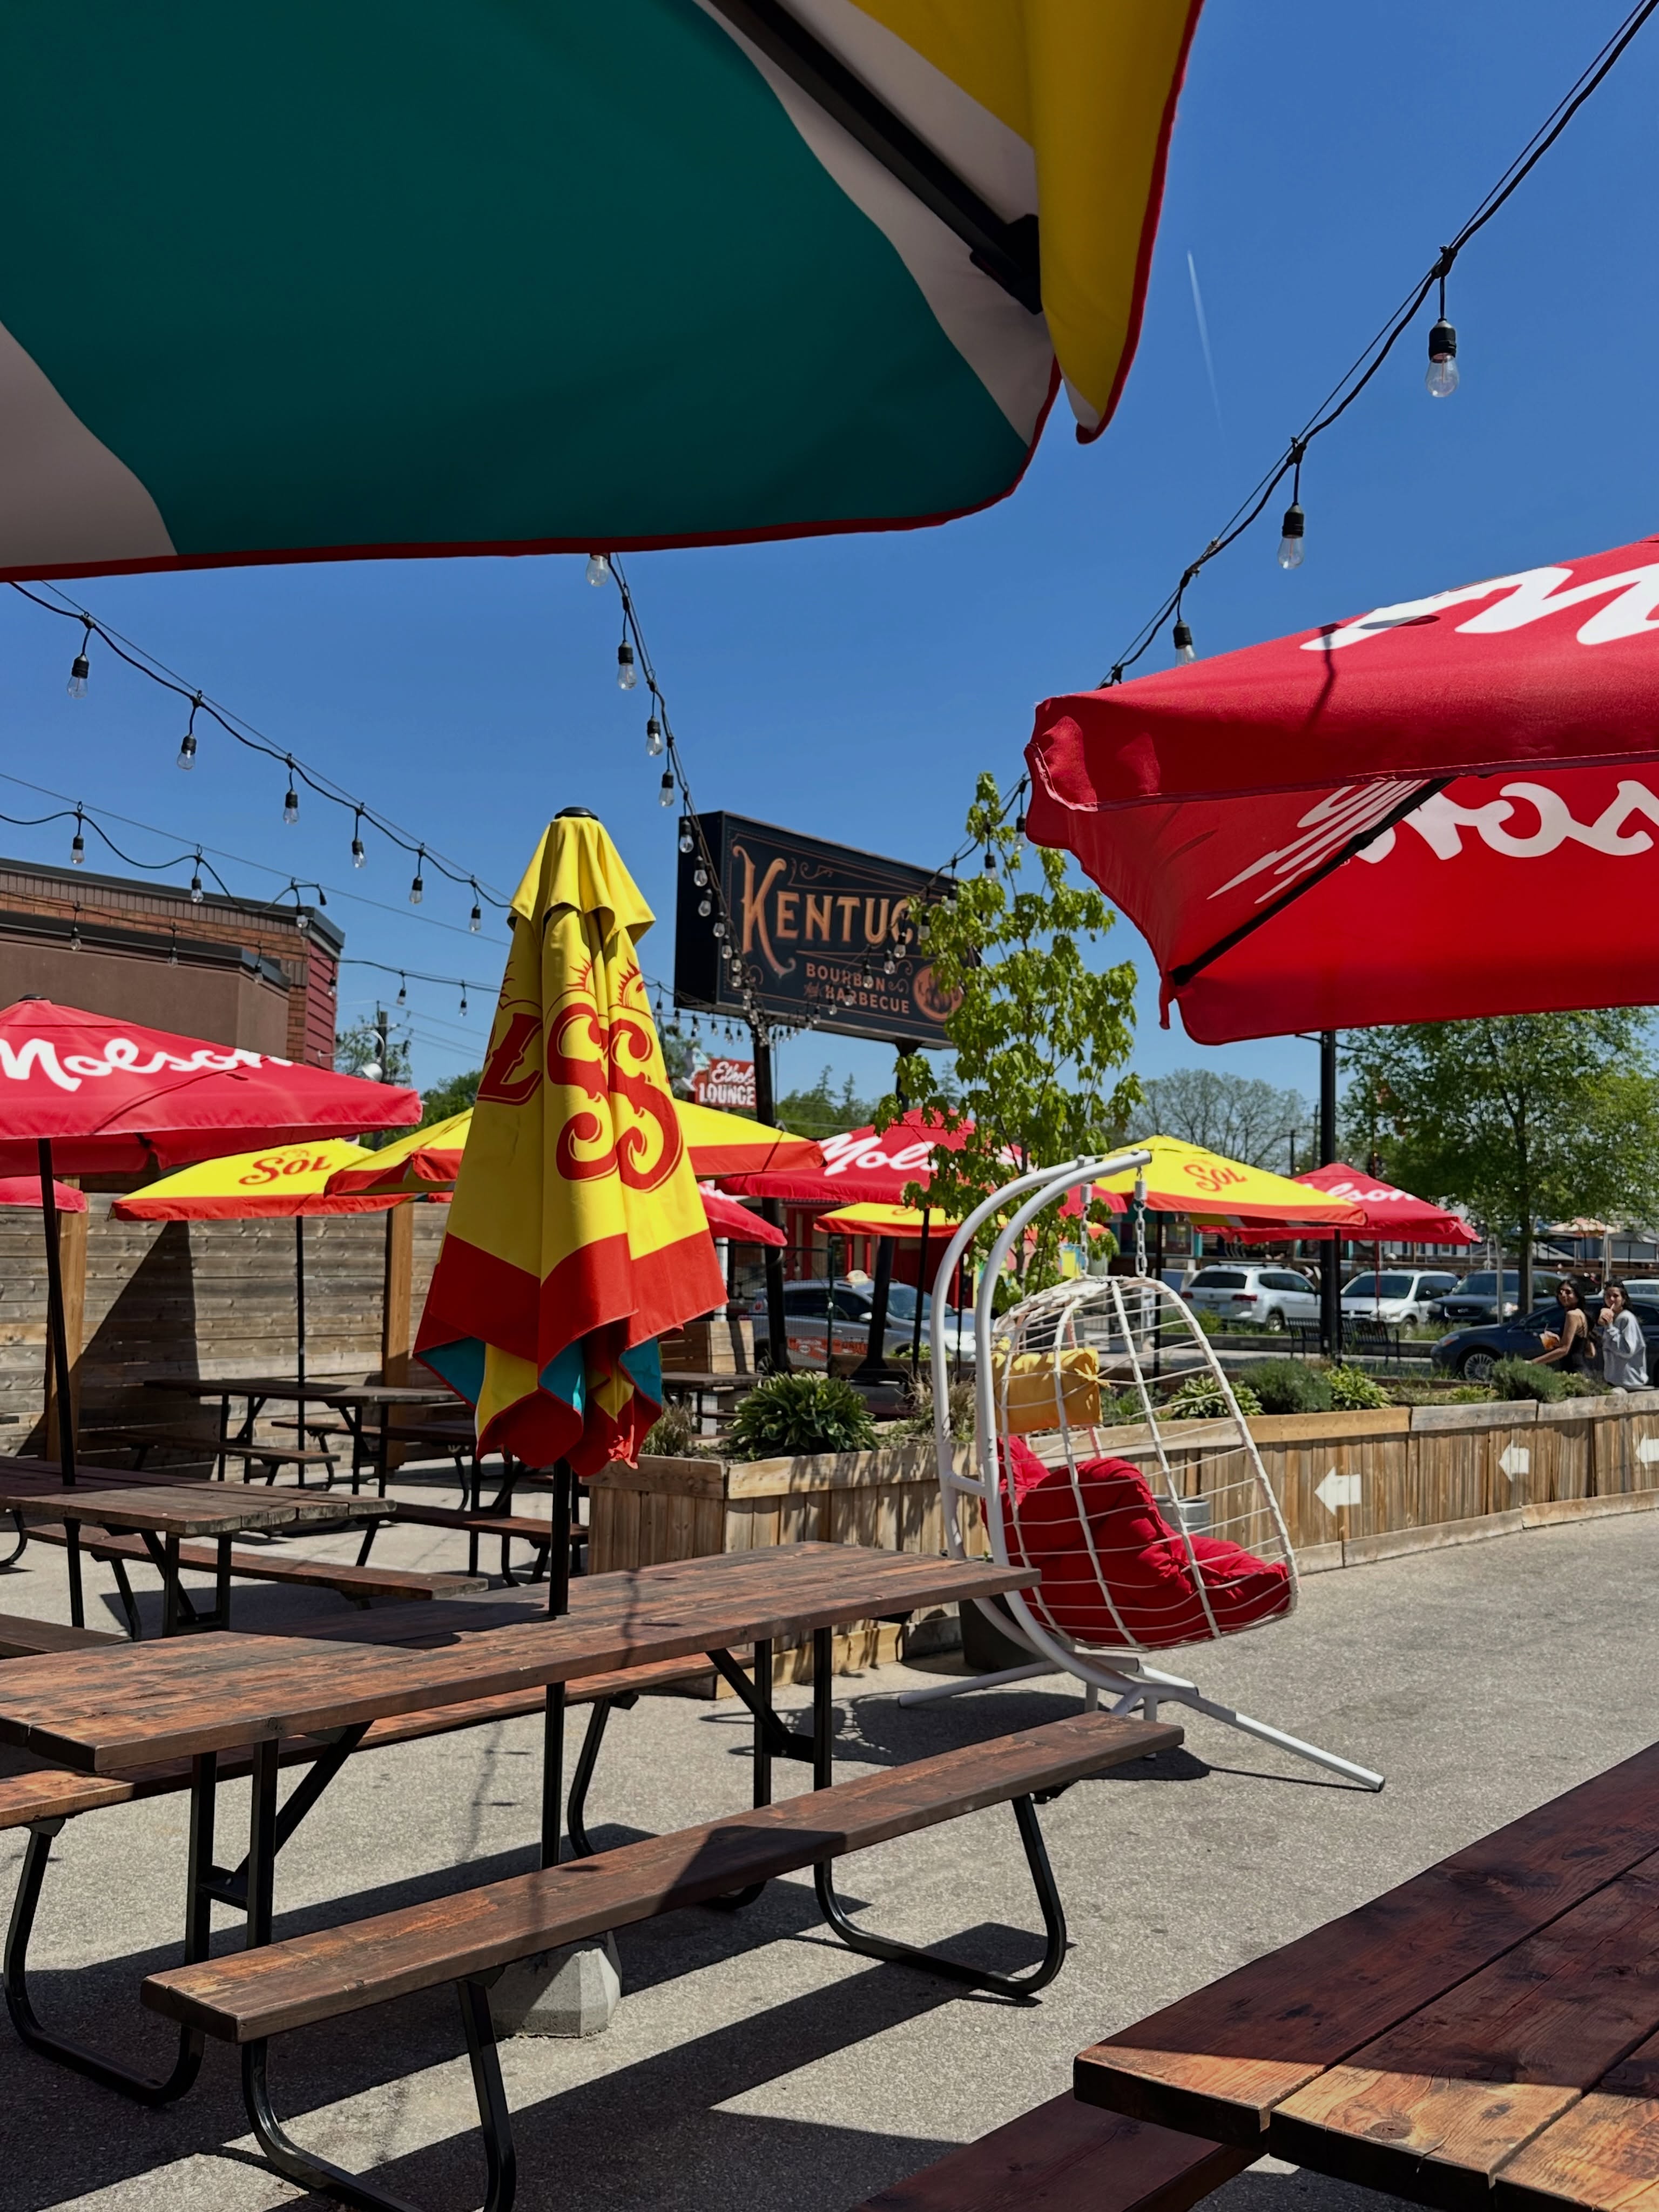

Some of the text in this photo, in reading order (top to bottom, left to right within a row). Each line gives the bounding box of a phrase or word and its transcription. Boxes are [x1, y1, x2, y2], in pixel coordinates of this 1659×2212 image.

[732, 846, 919, 979] KENTUC
[806, 963, 886, 992] BOURBN
[699, 1082, 756, 1106] LOUNGE
[819, 1132, 939, 1176] Mols
[1304, 1182, 1415, 1202] lson
